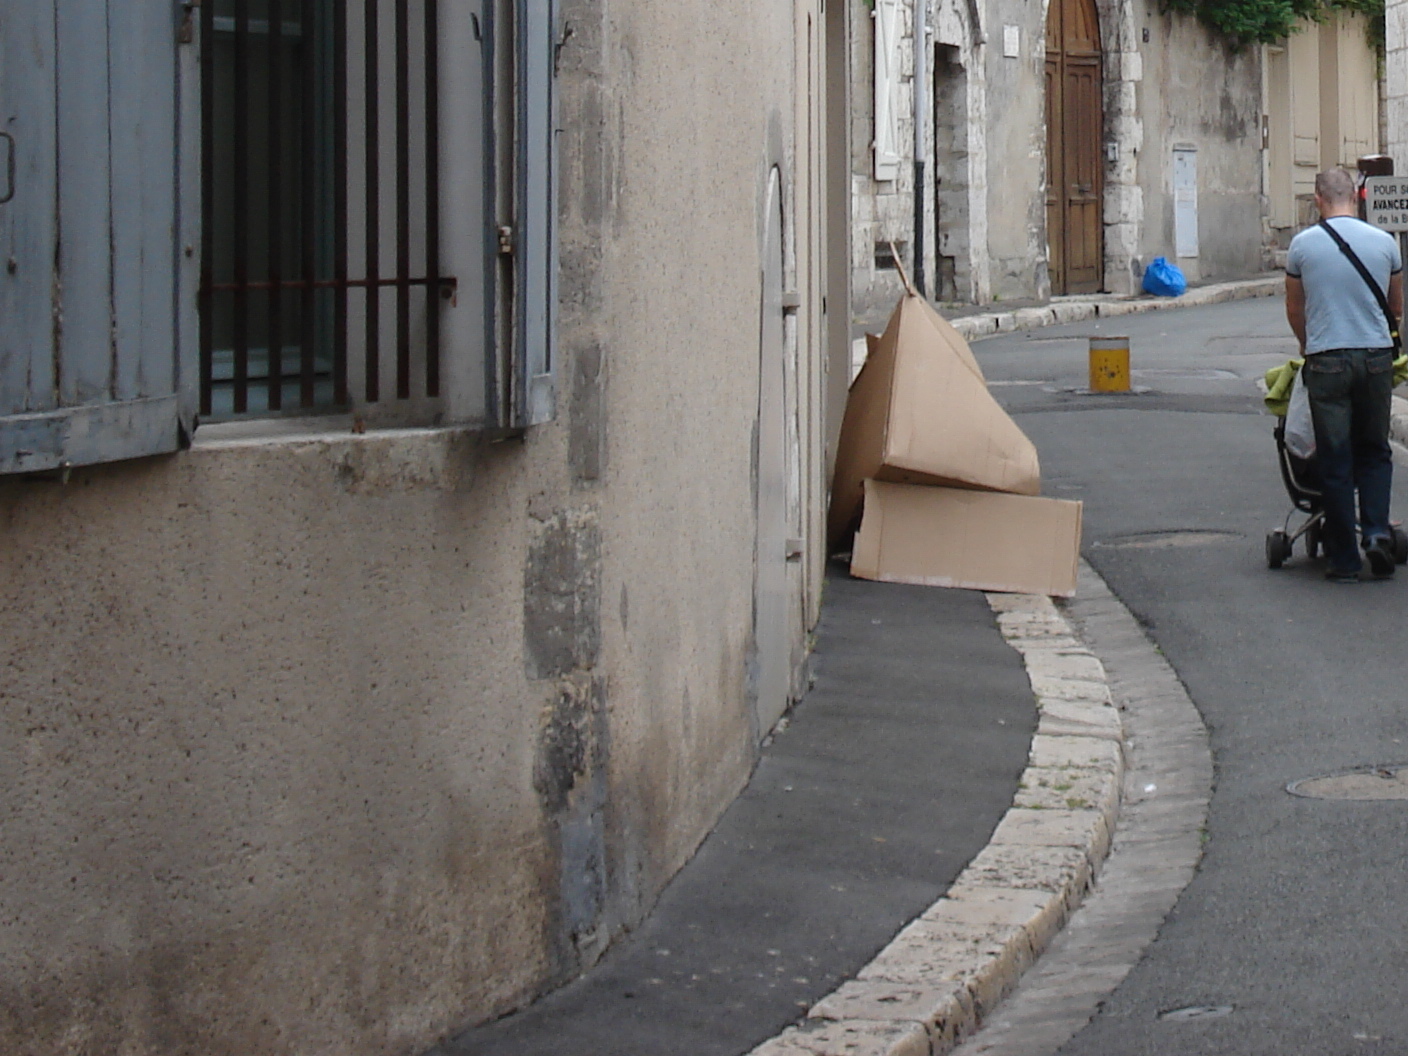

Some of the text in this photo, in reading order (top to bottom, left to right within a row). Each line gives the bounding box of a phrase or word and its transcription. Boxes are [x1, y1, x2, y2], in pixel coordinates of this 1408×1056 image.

[1373, 185, 1397, 196] POUR
[1377, 214, 1388, 224] de
[1391, 214, 1399, 224] la
